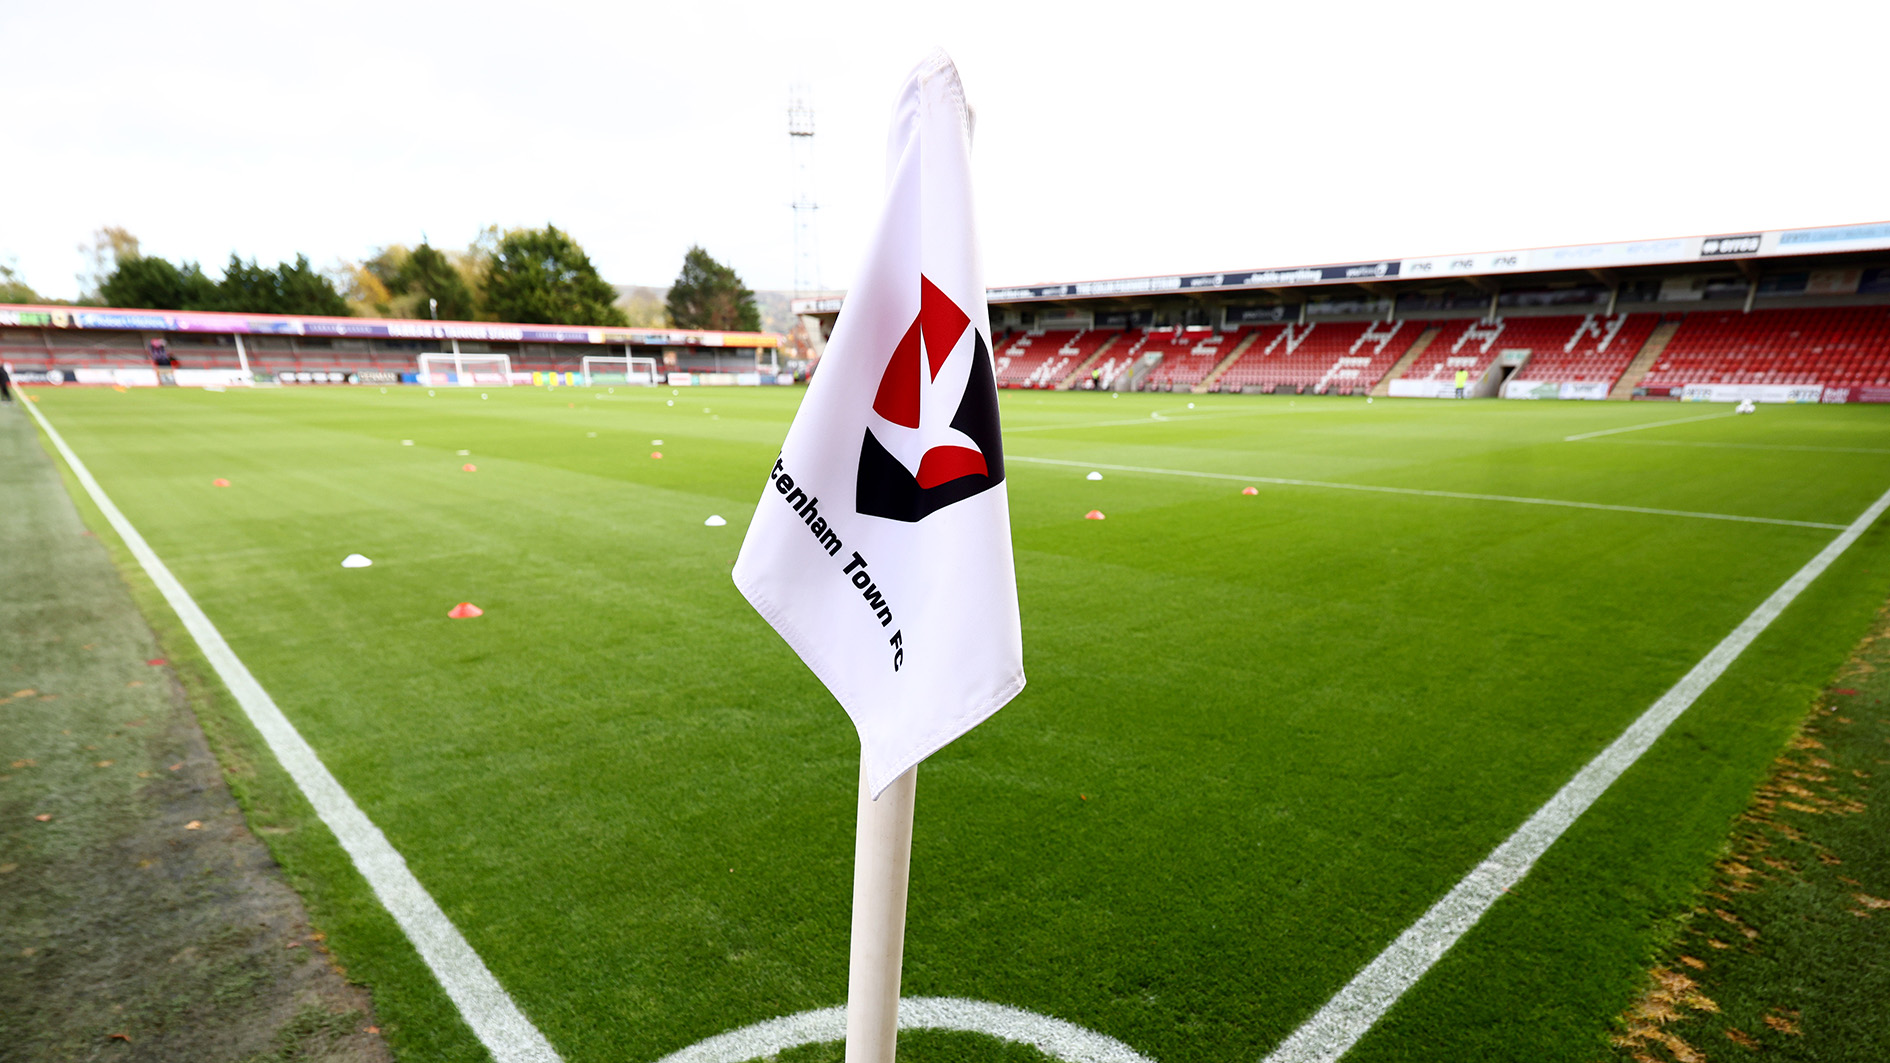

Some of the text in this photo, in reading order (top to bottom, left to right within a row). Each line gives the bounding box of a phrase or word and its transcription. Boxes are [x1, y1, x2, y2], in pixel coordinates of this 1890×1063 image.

[771, 451, 904, 672] tenham Town FC
